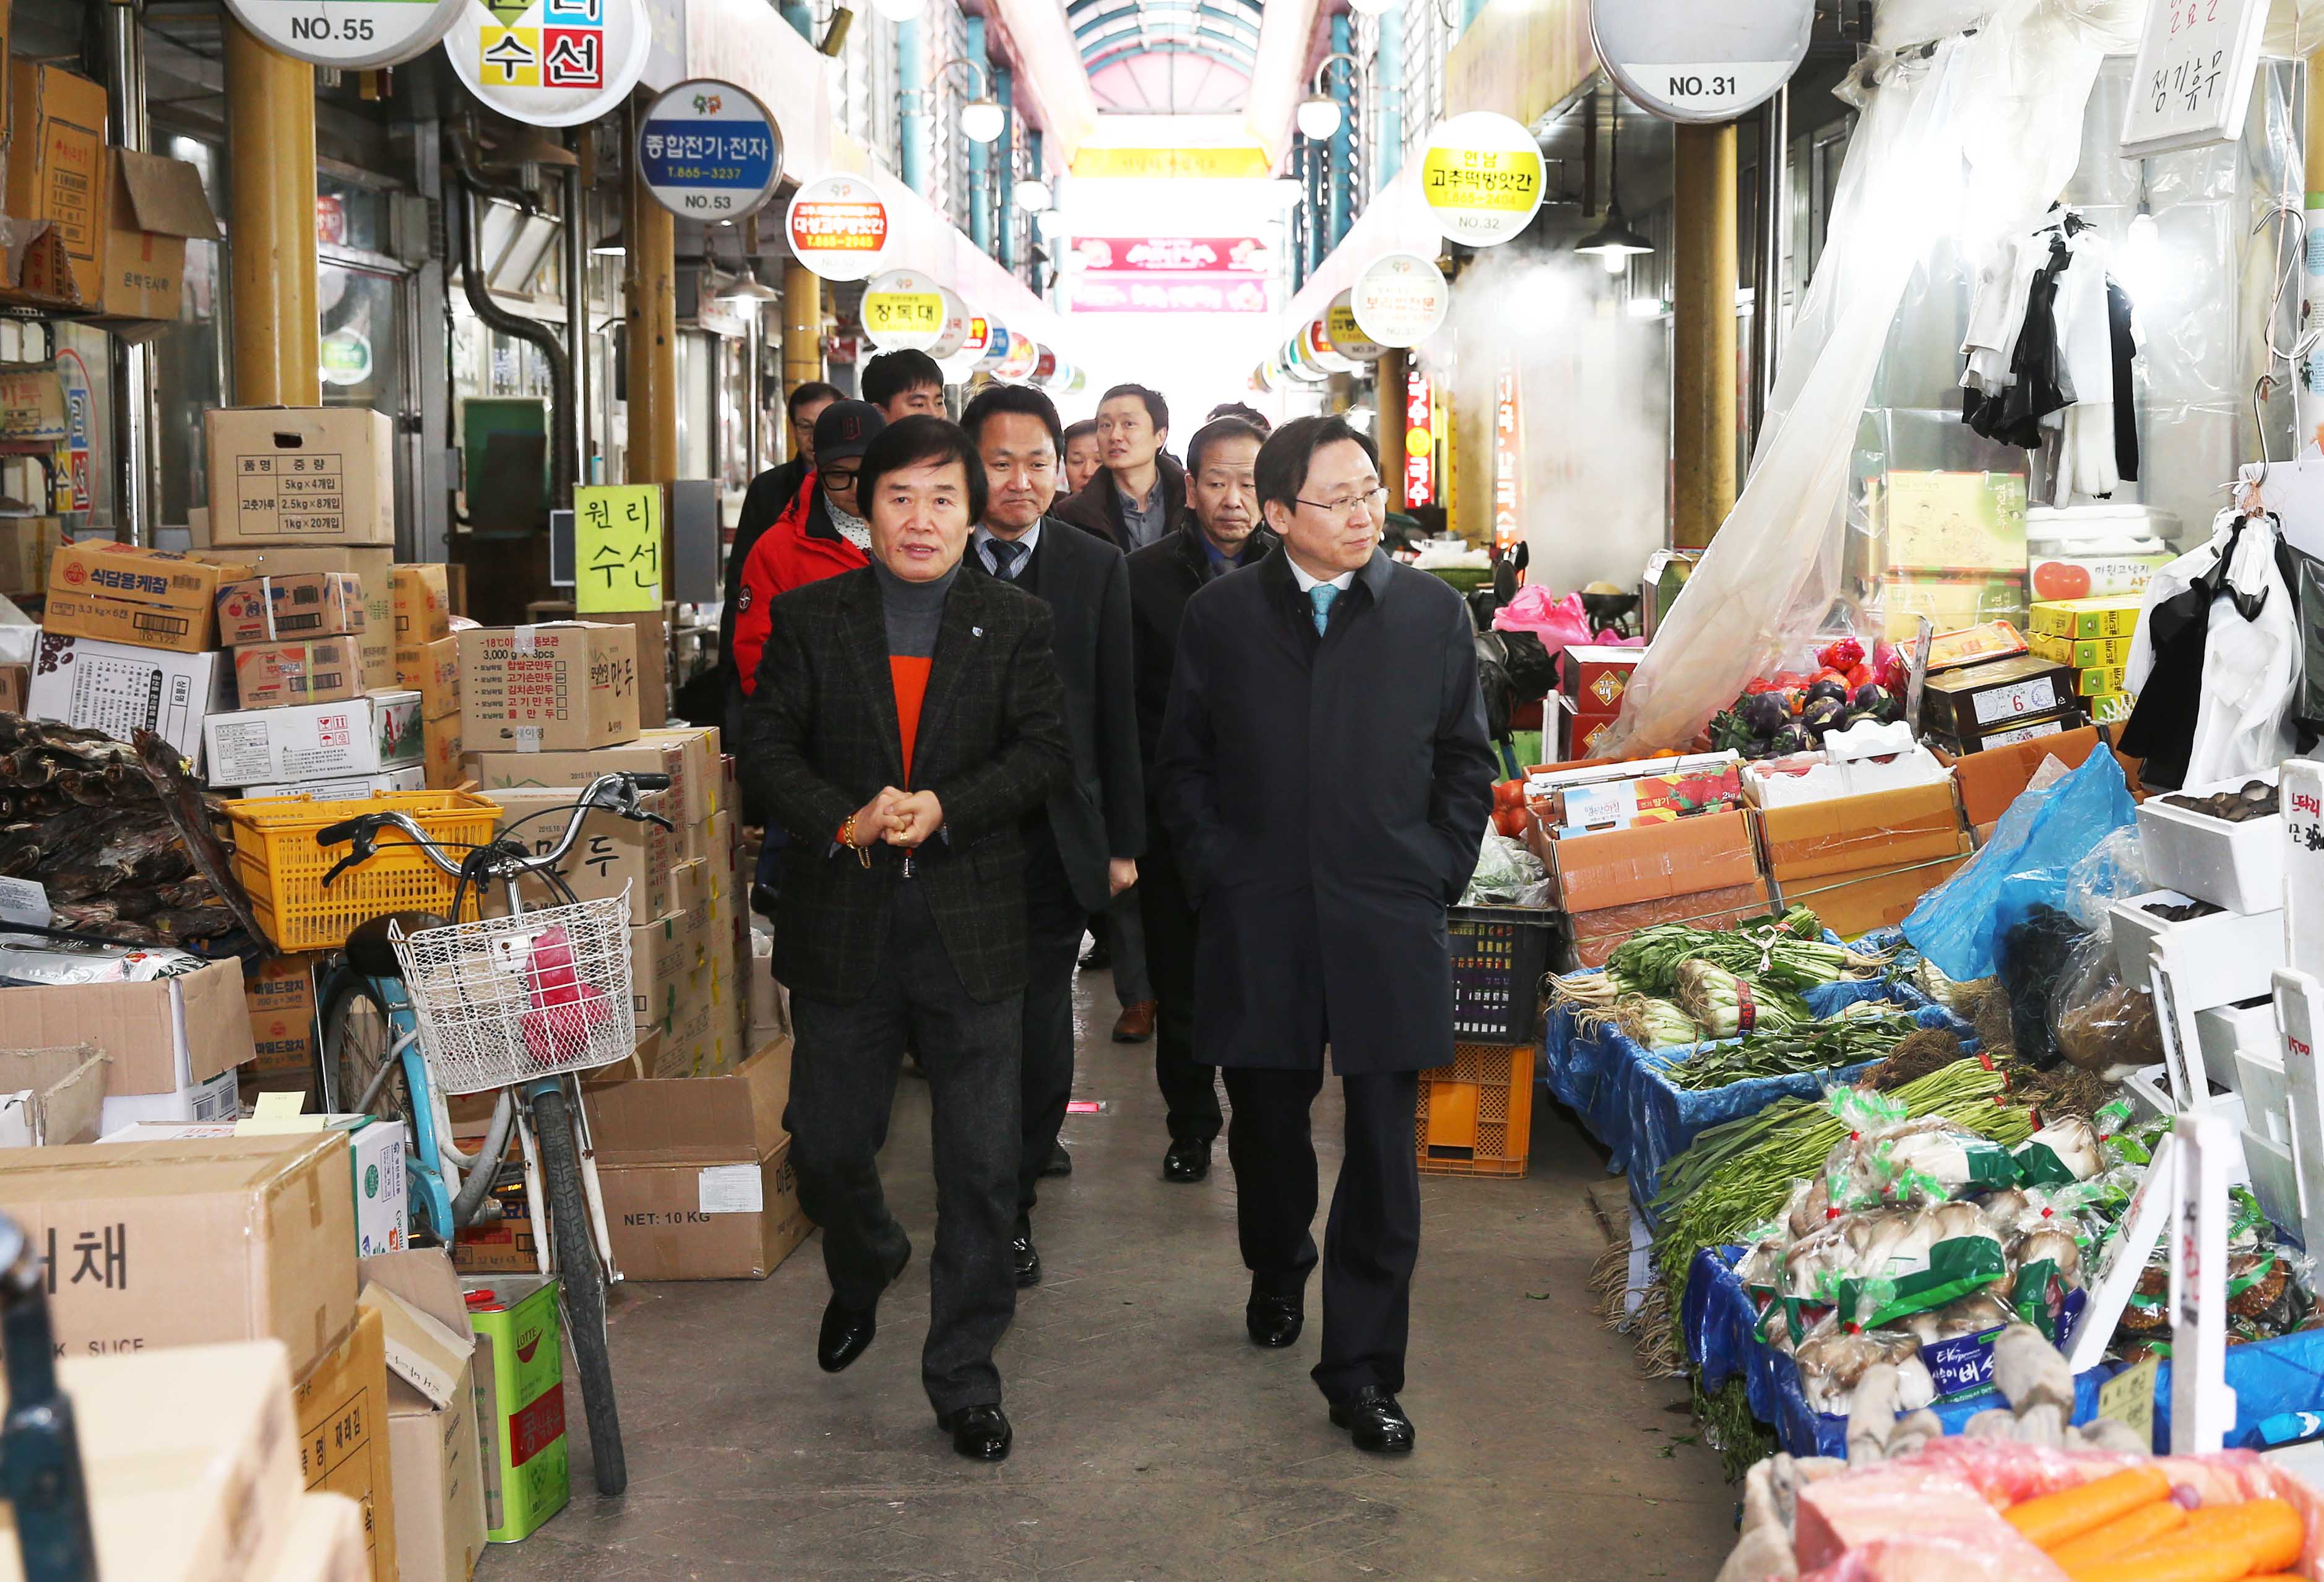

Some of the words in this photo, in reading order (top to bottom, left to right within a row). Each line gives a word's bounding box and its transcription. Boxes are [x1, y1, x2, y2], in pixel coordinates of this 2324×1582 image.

[291, 17, 374, 40] NO.55
[485, 35, 598, 82] 수선
[1670, 77, 1735, 95] NO.31
[2152, 50, 2223, 113] 정기휴무
[1431, 169, 1532, 192] 고추떡방앗간
[685, 195, 732, 209] NO.53
[1459, 217, 1500, 229] NO.32
[243, 499, 275, 511] 고춧가루
[585, 496, 649, 534] 원리
[590, 542, 659, 589] 수선
[2130, 576, 2152, 586] 사
[483, 650, 508, 660] 3,000
[533, 649, 555, 660] 3pcs
[507, 660, 553, 671] 찹쌀군만두
[507, 673, 553, 683] 고기손만두
[611, 659, 634, 697] 만두
[508, 685, 554, 695] 김치손만두
[2013, 695, 2023, 711] 6
[1652, 797, 1669, 807] 딸기
[1722, 791, 1736, 800] 2kg
[624, 1212, 660, 1225] NET:
[665, 1212, 681, 1224] 10
[687, 1211, 711, 1223] KG
[516, 1327, 537, 1349] LOTTE
[335, 1406, 361, 1449] 재래김
